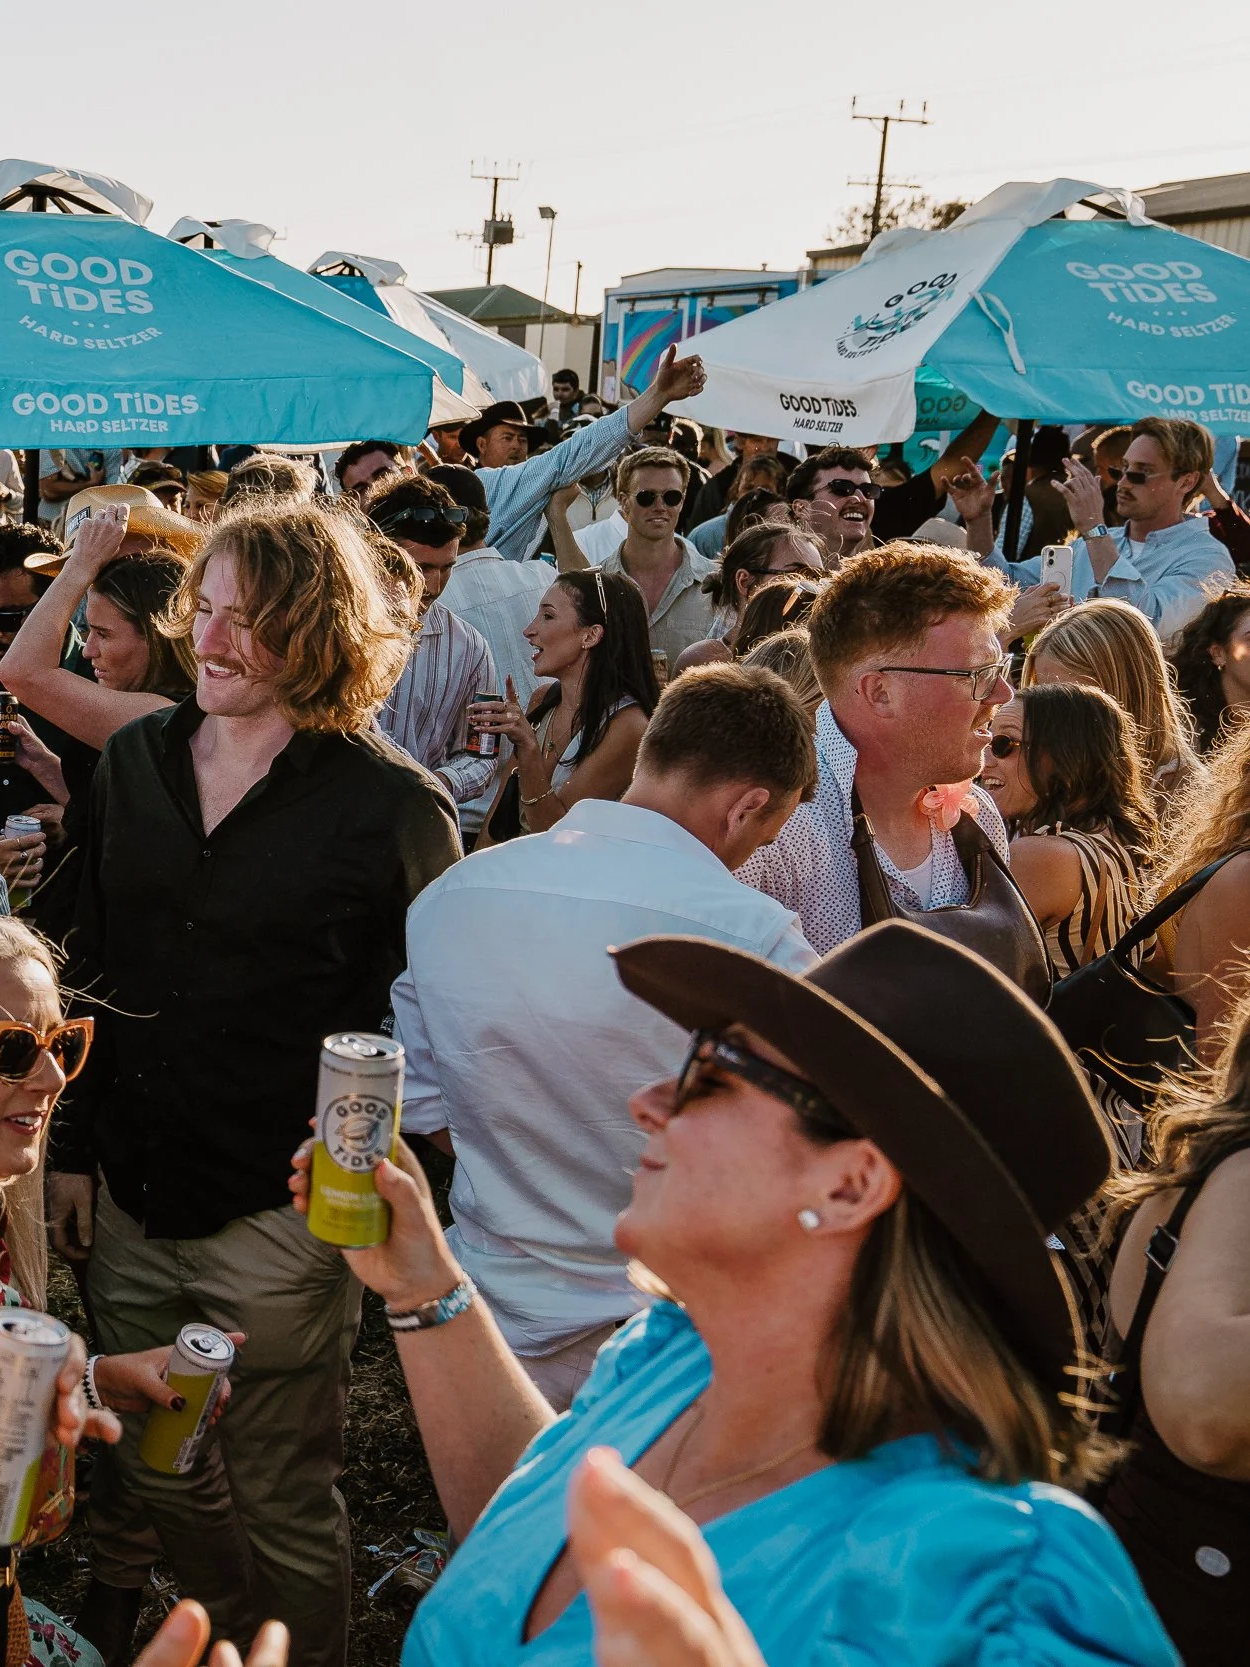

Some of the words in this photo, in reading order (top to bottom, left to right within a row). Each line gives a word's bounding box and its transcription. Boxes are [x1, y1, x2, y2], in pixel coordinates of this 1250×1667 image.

[4, 249, 153, 285] GOOD
[1066, 262, 1203, 280] GOOD
[883, 273, 957, 308] GOOD
[18, 315, 78, 346] HARD
[83, 327, 163, 350] SELTZER
[1108, 312, 1165, 336] HARD
[1169, 314, 1237, 337] SELTZER
[779, 393, 821, 414] GOOD
[1127, 380, 1205, 406] GOOD
[1208, 383, 1250, 405] TiD
[12, 393, 108, 416] GOOD
[1199, 408, 1250, 423] SELTZE
[51, 419, 98, 433] HARD
[101, 418, 169, 433] SELTZER
[793, 418, 815, 430] HARD
[815, 421, 843, 433] SELTZER
[336, 1101, 388, 1121] GOOD
